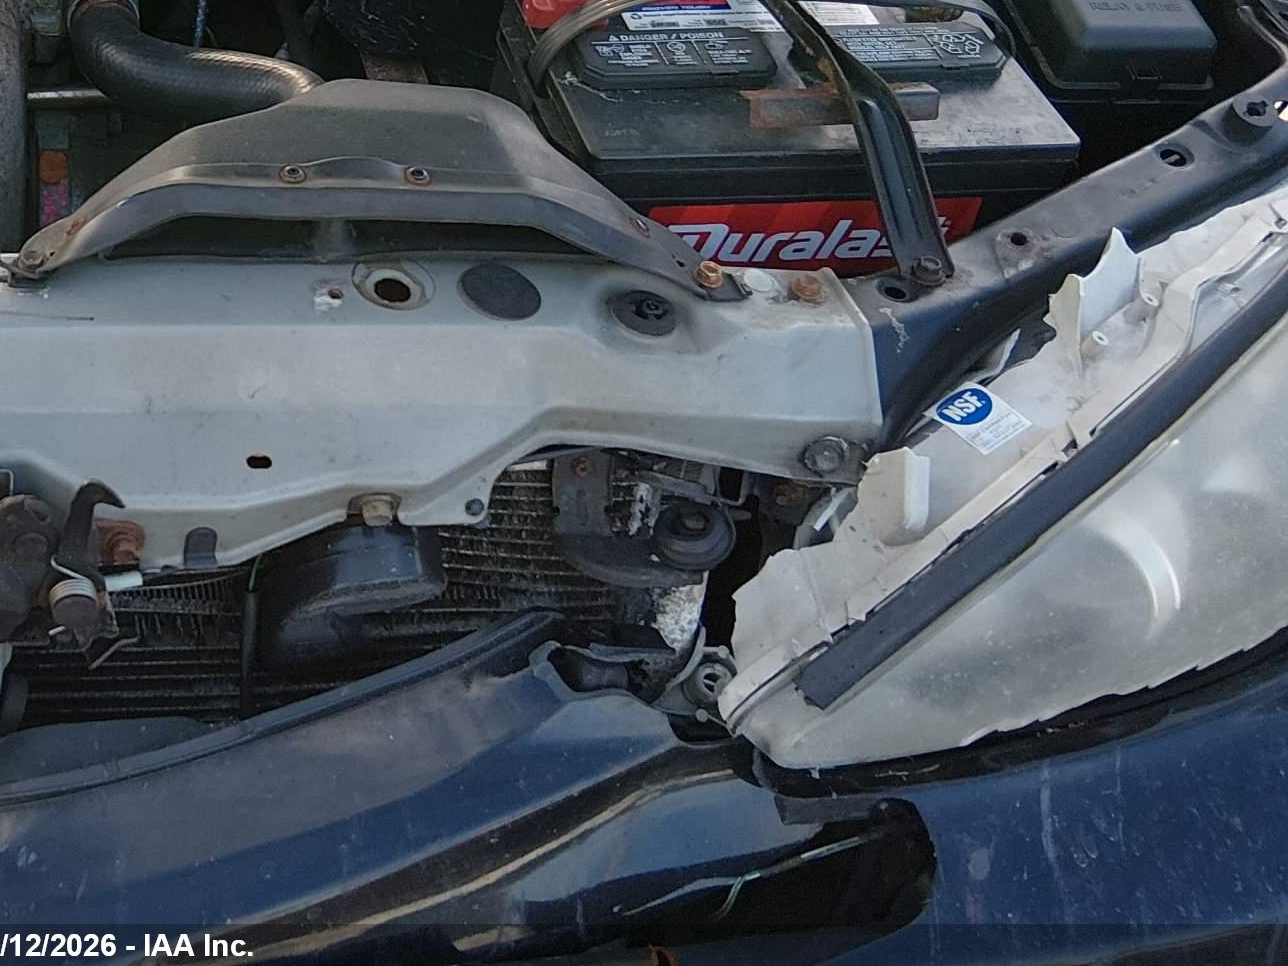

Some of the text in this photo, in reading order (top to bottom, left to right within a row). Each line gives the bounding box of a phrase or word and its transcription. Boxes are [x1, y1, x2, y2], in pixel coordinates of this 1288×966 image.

[619, 33, 669, 42] DANGER
[679, 31, 725, 40] POISON
[941, 390, 983, 422] NSF
